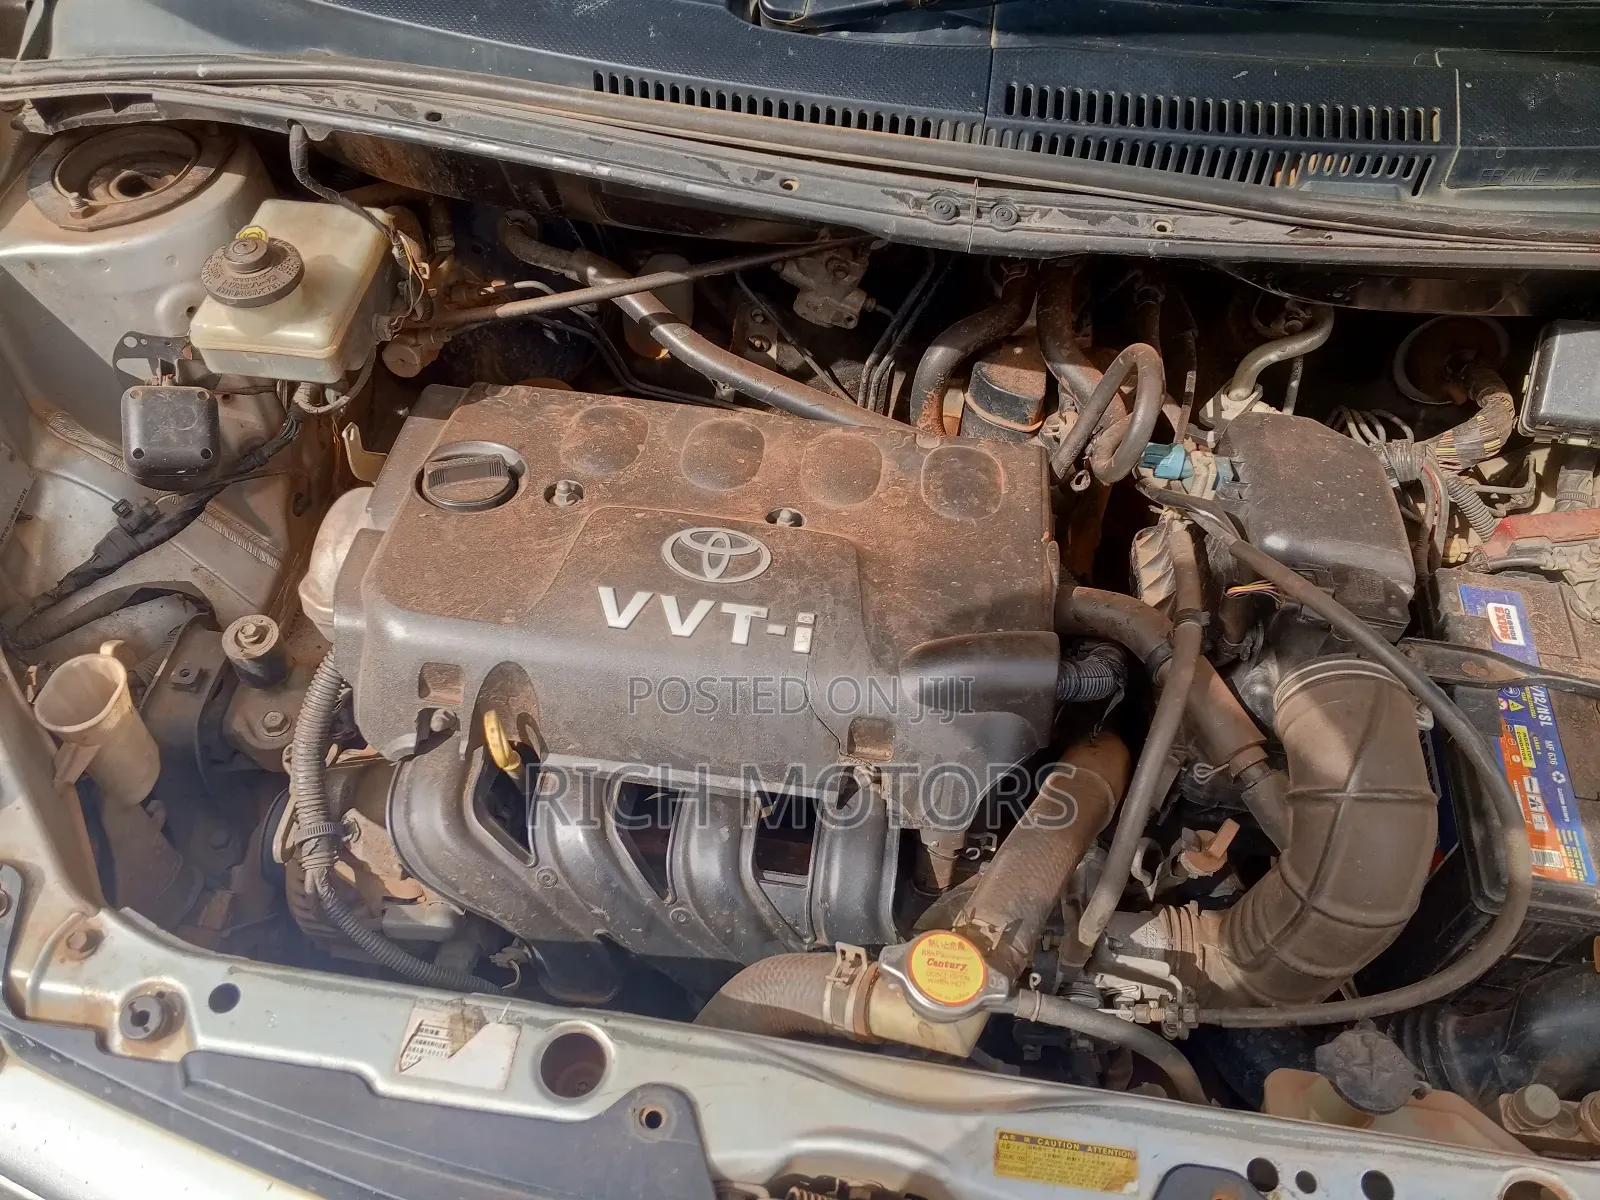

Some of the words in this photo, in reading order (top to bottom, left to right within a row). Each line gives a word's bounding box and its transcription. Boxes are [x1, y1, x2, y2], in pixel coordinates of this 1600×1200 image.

[1479, 167, 1549, 183] FRAME
[597, 586, 817, 655] VVT-i
[1493, 606, 1511, 641] EXIDE
[1504, 607, 1518, 641] CHLORIDE
[927, 958, 967, 972] Century
[1037, 1138, 1080, 1151] CAUTION
[1087, 1145, 1134, 1159] ATTENTION
